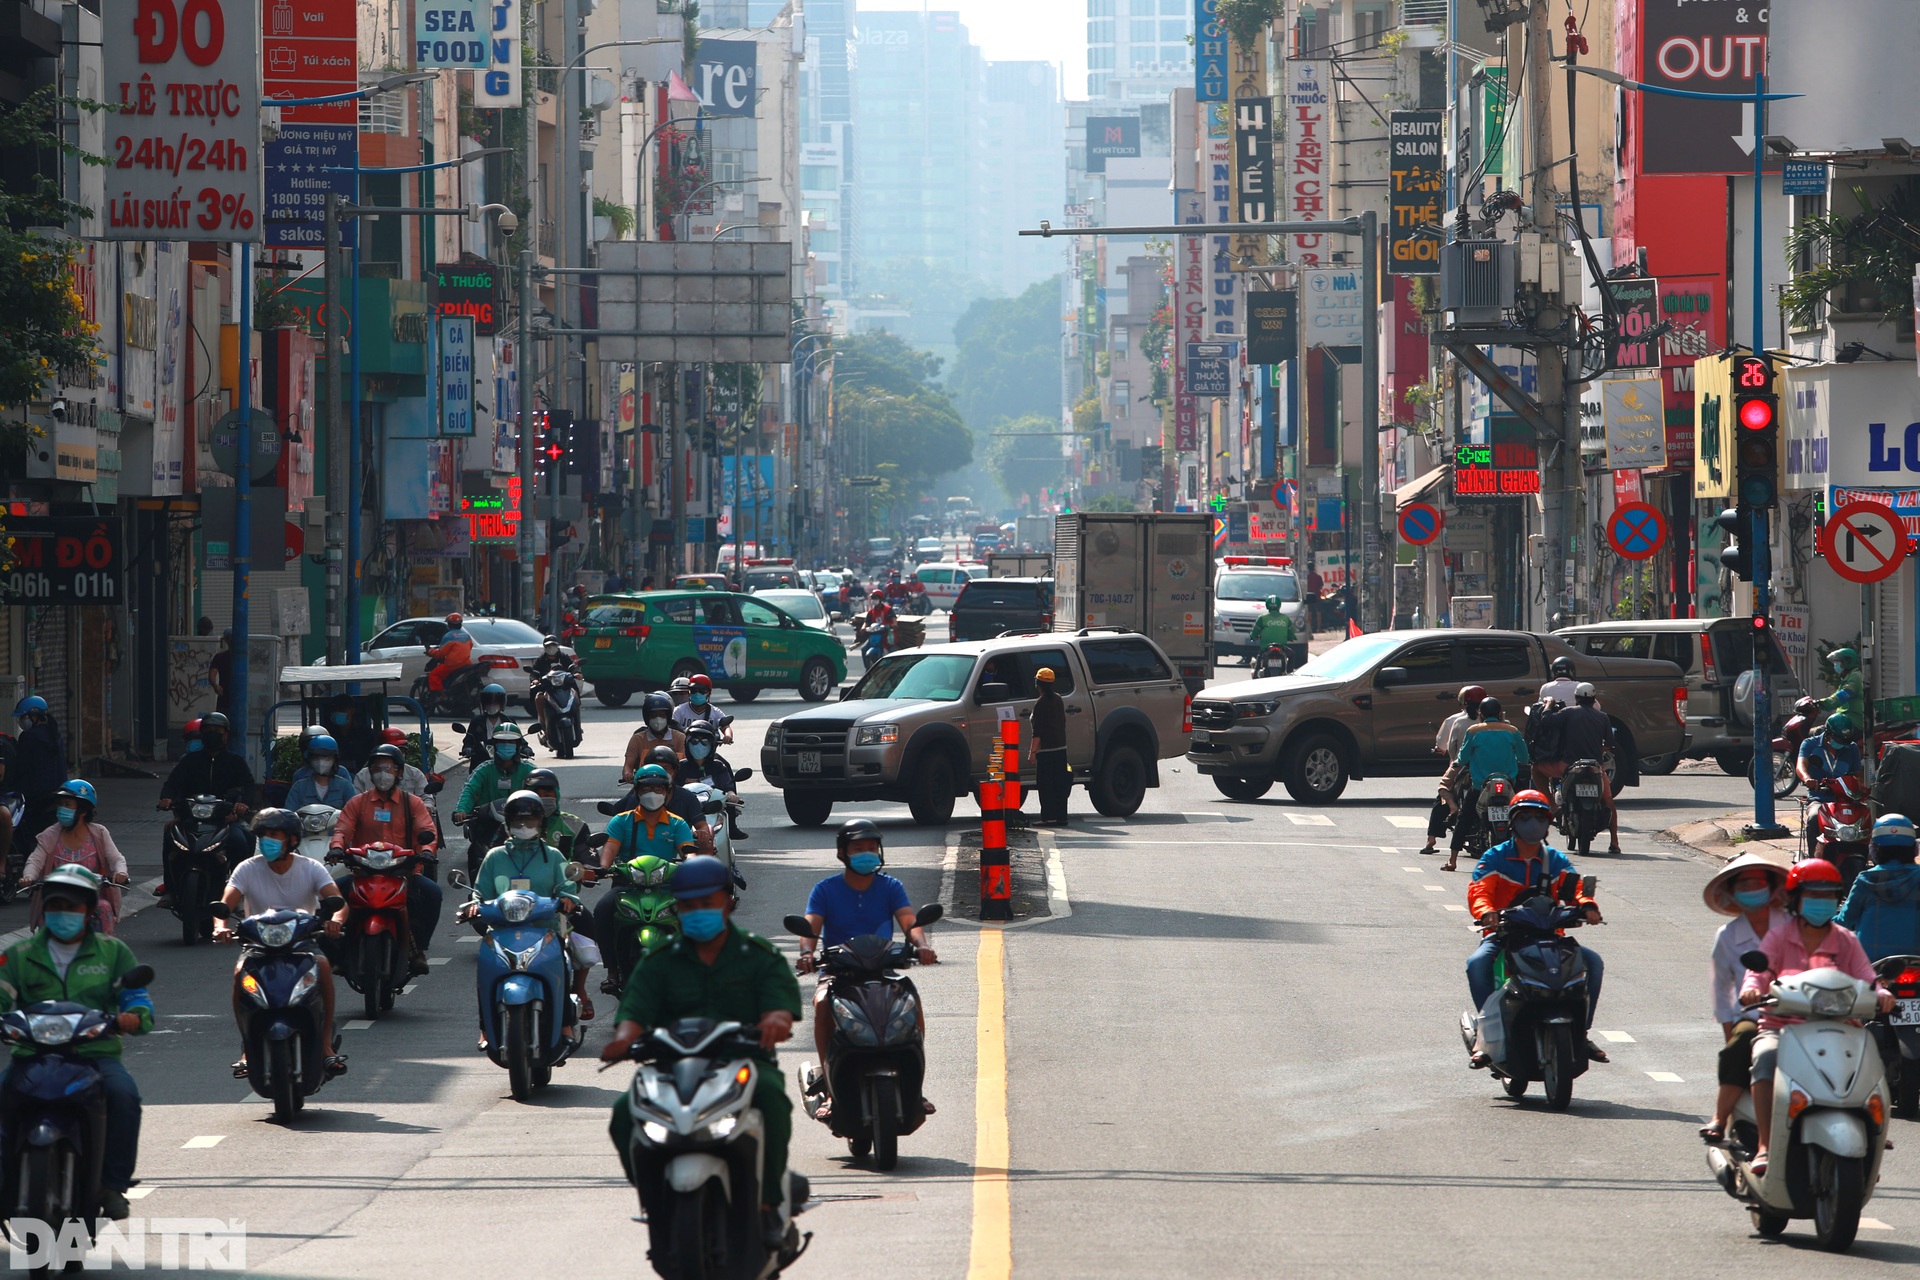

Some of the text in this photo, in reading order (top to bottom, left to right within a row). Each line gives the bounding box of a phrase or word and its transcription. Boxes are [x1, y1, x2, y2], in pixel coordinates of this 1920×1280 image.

[303, 12, 324, 22] Vali
[425, 10, 475, 32] SEA
[1736, 8, 1750, 23] &
[303, 54, 350, 66] Túi xách
[416, 40, 484, 62] FOOD
[1658, 37, 1769, 80] OUT
[1297, 80, 1319, 91] NHÀ
[120, 72, 241, 126] LÊ TRỰC
[1290, 91, 1327, 104] THUỐC
[314, 130, 335, 142] HIỆU
[338, 130, 353, 140] MỸ
[1392, 122, 1440, 136] BEAUTY
[1294, 106, 1323, 174] LIÊN
[1396, 141, 1438, 156] SALON
[115, 132, 246, 177] 24h/24h
[284, 144, 337, 157] GIÁ TRỊ MỸ
[290, 177, 331, 189] Hotline:
[110, 186, 254, 230] LÃI SUẤT 3%
[272, 193, 326, 205] 1800 599
[1394, 196, 1438, 227] THẾ
[1393, 234, 1438, 261] GIỚI
[1186, 238, 1202, 295] LIÊN
[452, 272, 492, 289] THUỐC
[1333, 272, 1356, 290] NHÀ
[1254, 308, 1287, 318] COLOR
[1662, 292, 1710, 316] VIỆN ĐÀO TẠO
[450, 324, 464, 344] CÁ
[1262, 320, 1282, 330] MAN
[444, 348, 469, 372] BIỂN
[1616, 342, 1648, 366] MI
[1200, 360, 1220, 370] NHÀ
[1741, 363, 1764, 387] 26
[448, 378, 468, 401] MỖI
[448, 408, 466, 429] GIỜ
[10, 572, 50, 598] 06h
[74, 572, 114, 598] 01h
[802, 752, 816, 762] 54Y
[800, 762, 819, 773] 4472
[77, 963, 108, 975] Grab
